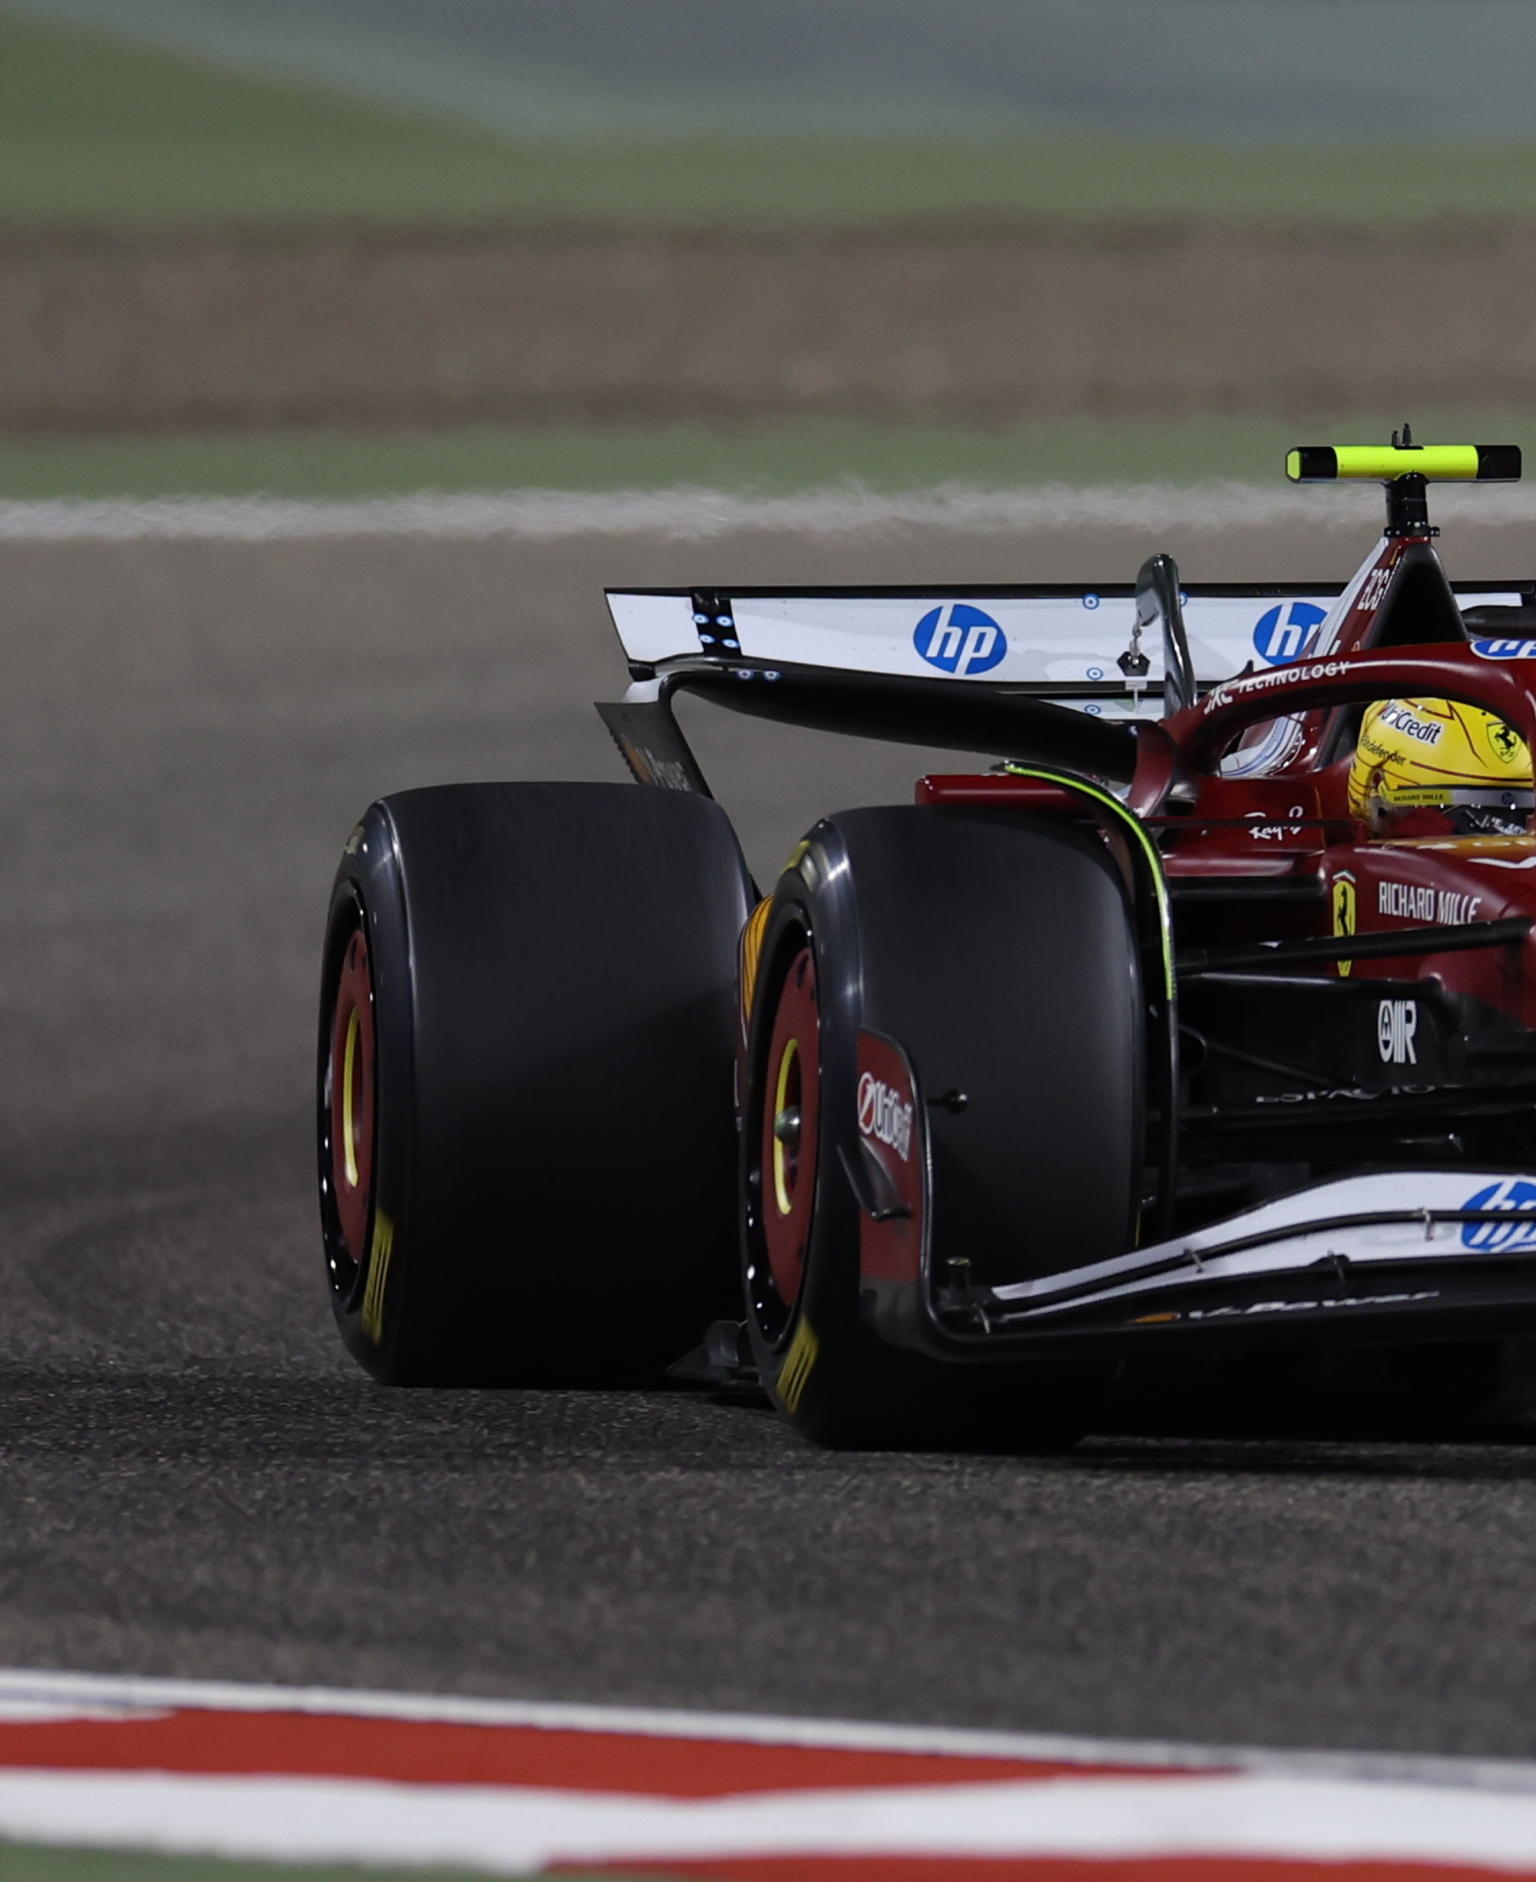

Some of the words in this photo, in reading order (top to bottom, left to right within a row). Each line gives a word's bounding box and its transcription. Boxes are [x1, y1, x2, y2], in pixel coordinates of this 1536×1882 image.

[924, 604, 999, 675] hp
[1238, 661, 1350, 694] TECHNOLOGY
[1378, 881, 1435, 922] RICHARD
